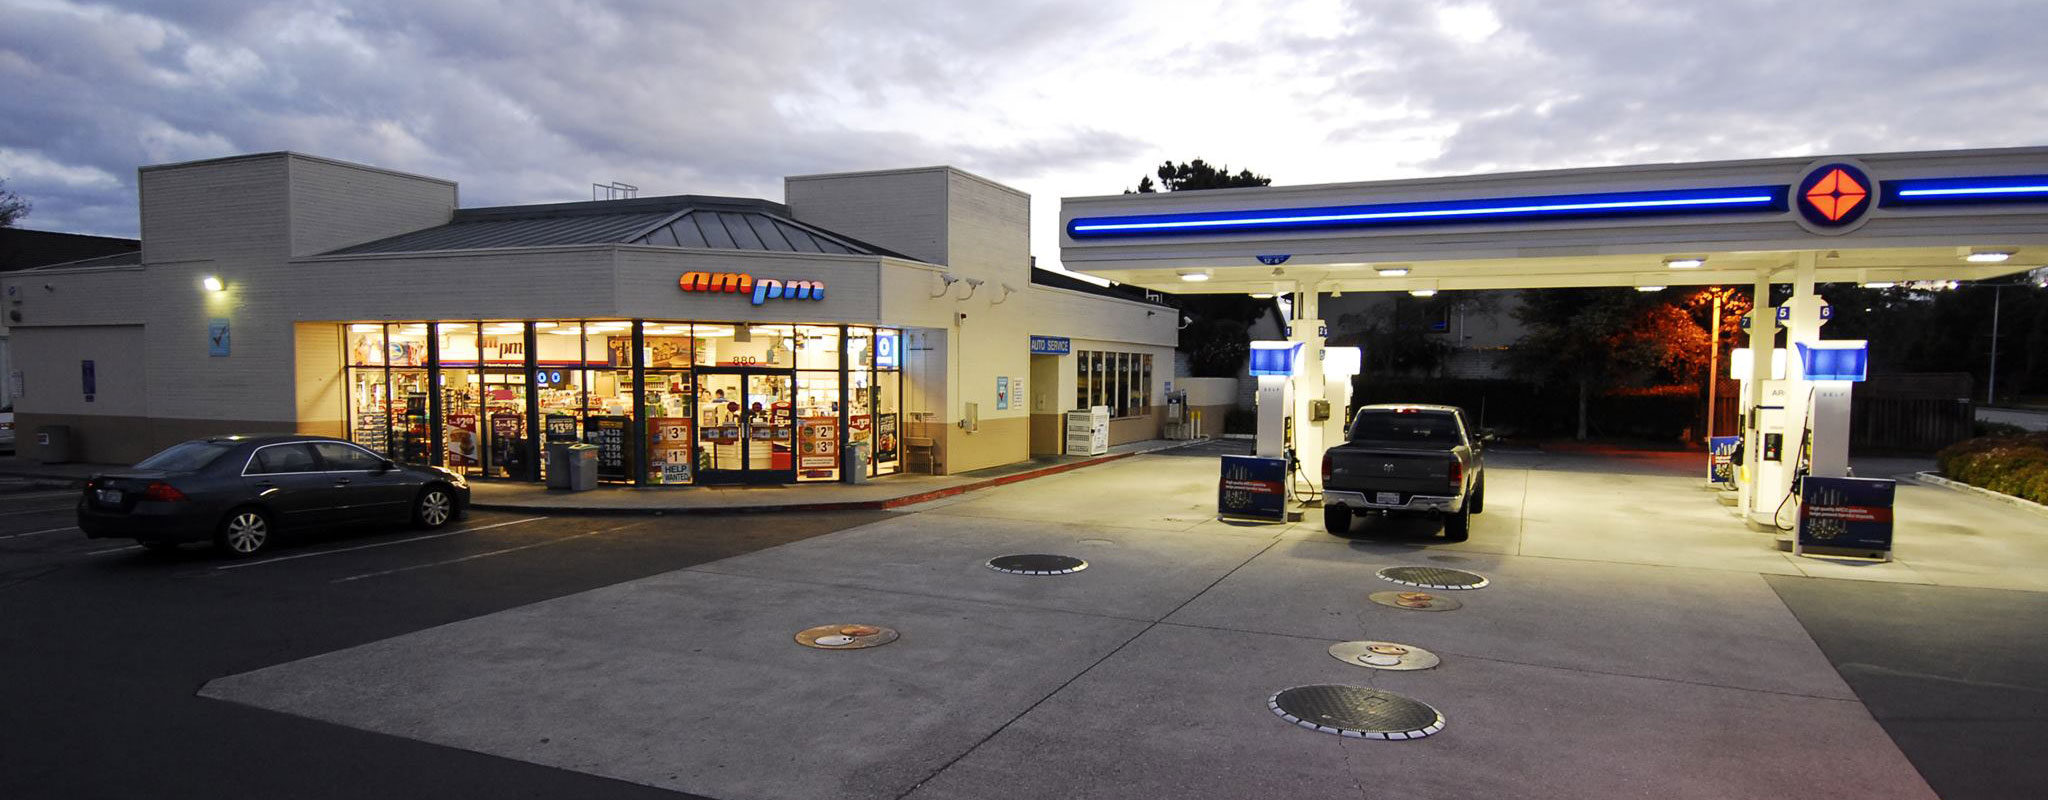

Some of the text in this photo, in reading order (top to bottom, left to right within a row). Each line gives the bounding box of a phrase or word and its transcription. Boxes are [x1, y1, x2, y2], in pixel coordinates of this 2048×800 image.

[1779, 308, 1787, 318] 5
[1822, 307, 1830, 317] 6
[1742, 318, 1748, 326] 7
[1286, 327, 1291, 335] 1
[1319, 327, 1324, 335] 2
[1031, 339, 1069, 352] AUTO SERVICE
[733, 356, 757, 366] 880
[506, 420, 518, 431] $5
[665, 465, 687, 473] HELP
[665, 472, 689, 481] WANTED
